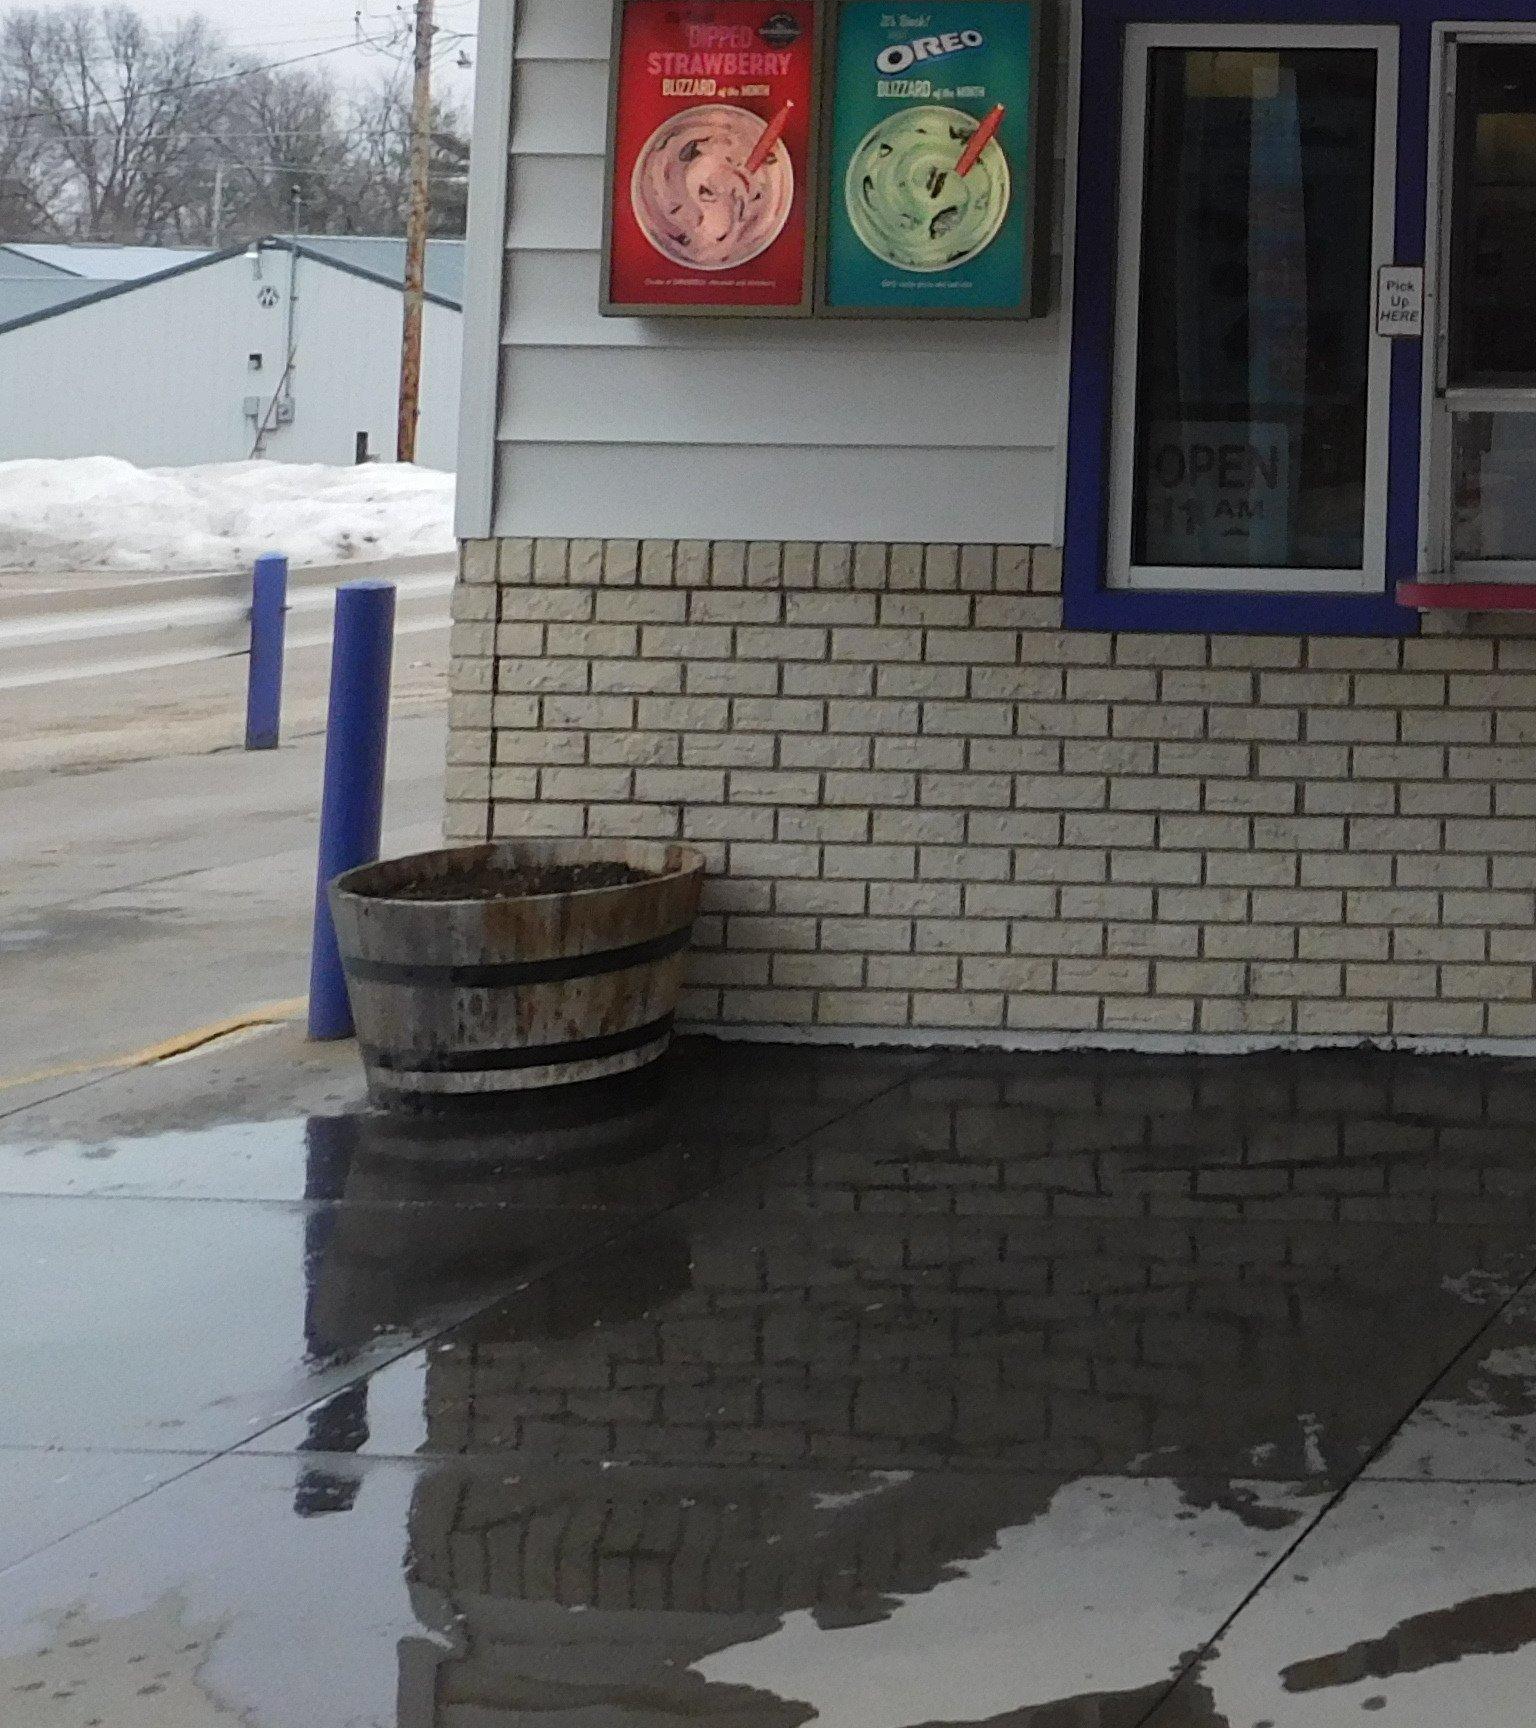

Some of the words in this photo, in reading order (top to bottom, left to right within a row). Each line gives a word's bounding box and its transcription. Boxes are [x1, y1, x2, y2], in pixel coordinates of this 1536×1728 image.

[876, 30, 982, 73] OREO
[648, 52, 792, 75] STRAWBERRY
[662, 78, 717, 96] BLIZZARD
[877, 80, 931, 98] BLIZZARD
[1386, 280, 1415, 291] Pick
[1391, 296, 1410, 309] Up
[1380, 311, 1419, 322] HERE
[1155, 443, 1279, 490] OPEN
